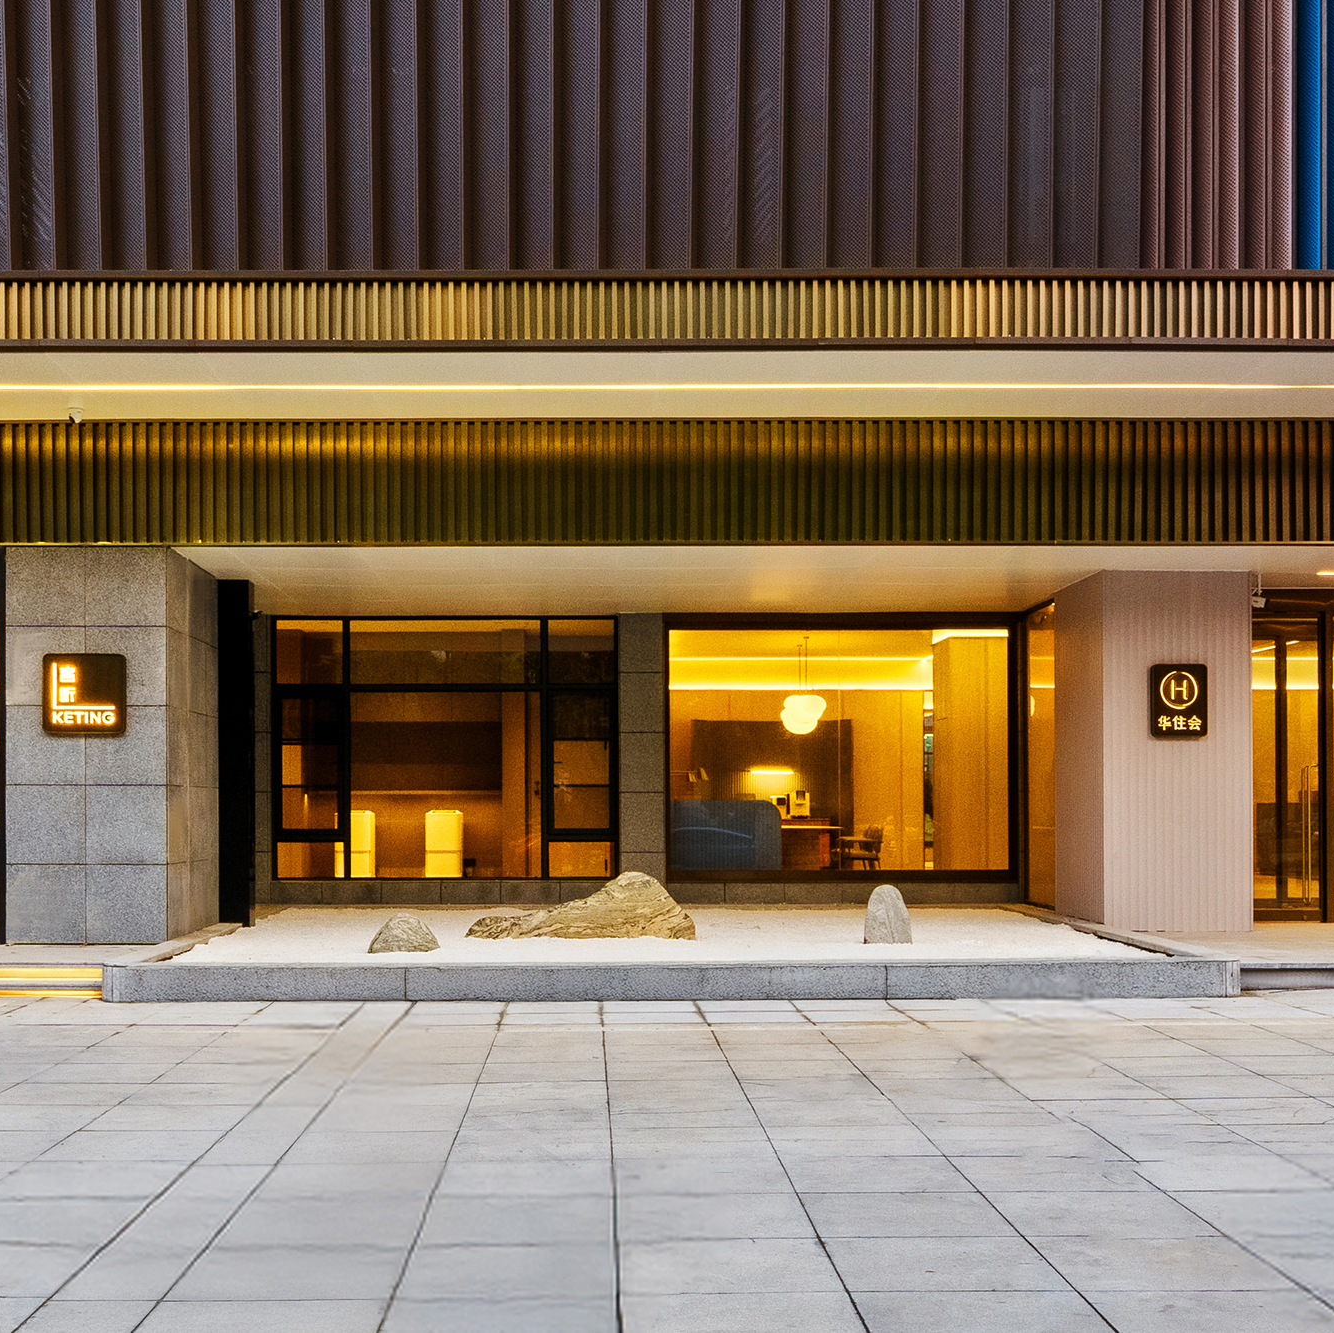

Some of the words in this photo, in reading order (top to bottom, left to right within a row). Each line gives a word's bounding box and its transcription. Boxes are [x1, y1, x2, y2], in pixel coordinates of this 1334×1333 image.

[52, 711, 116, 725] KETING
[1158, 714, 1202, 731] 华住会
